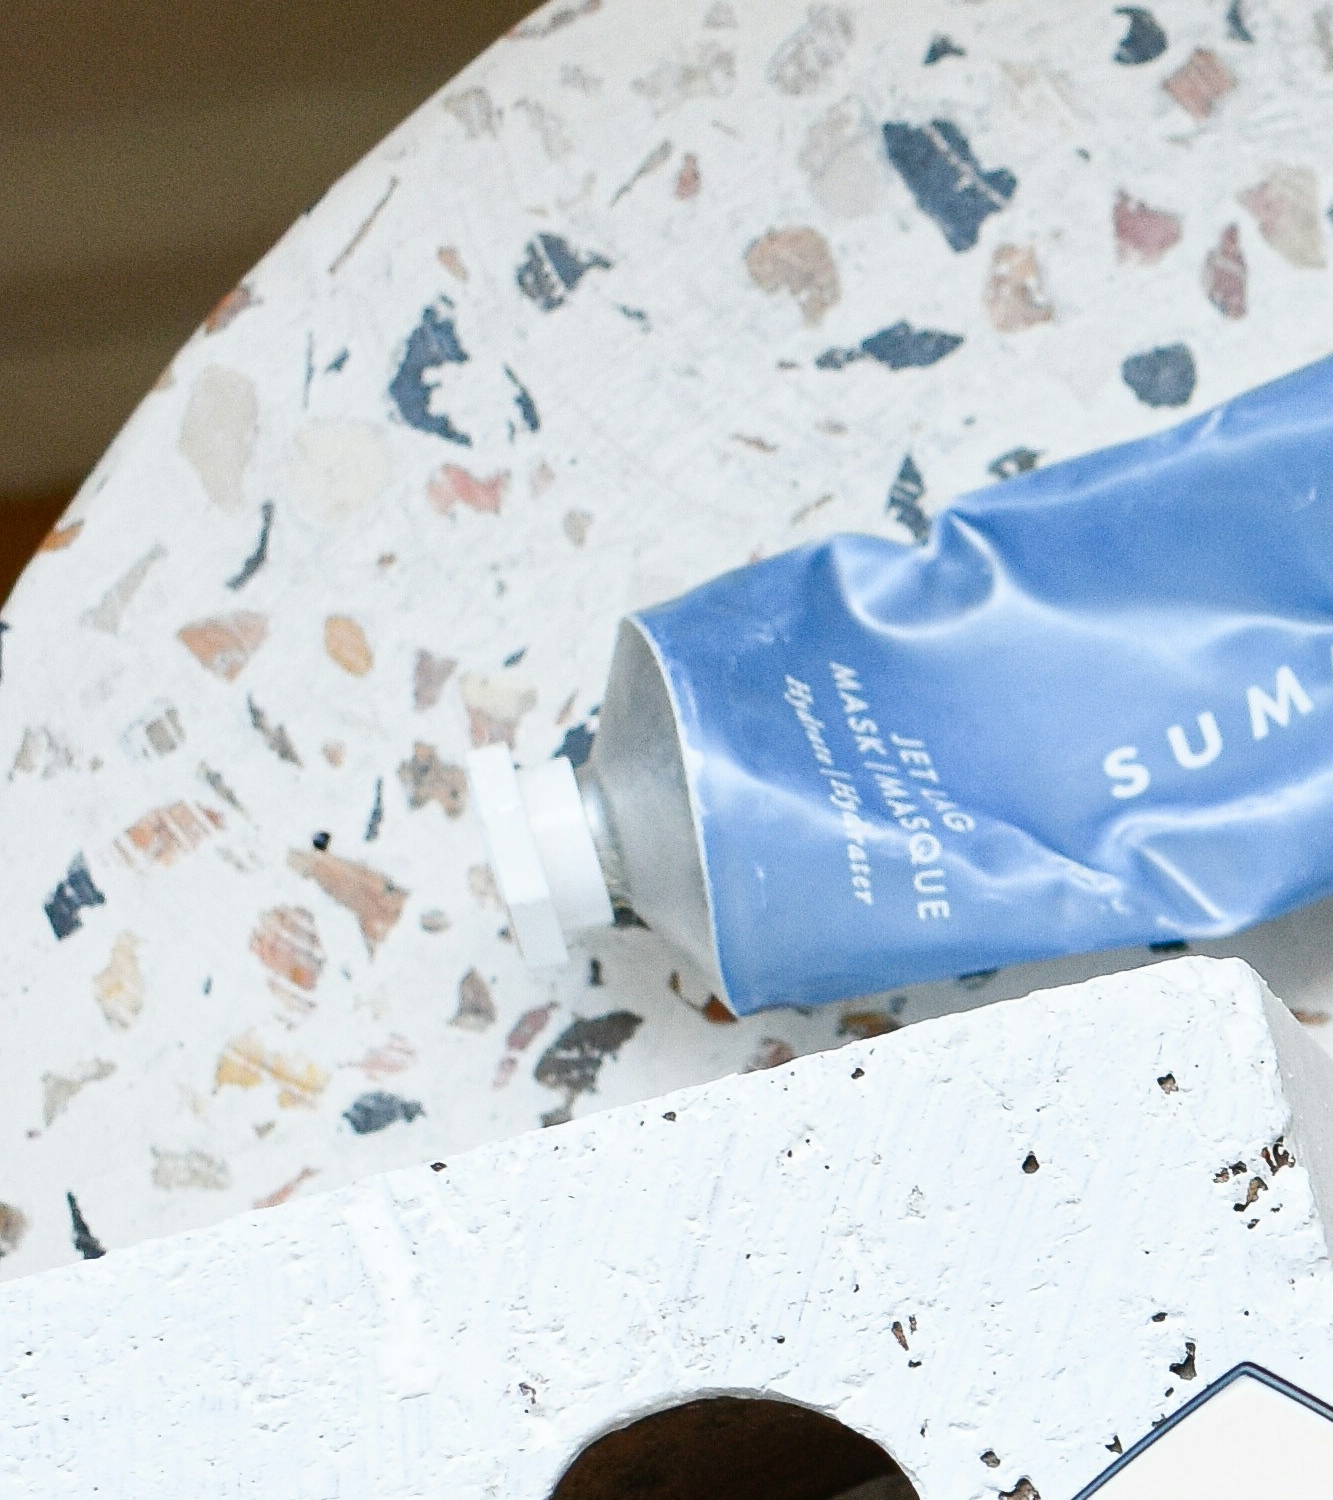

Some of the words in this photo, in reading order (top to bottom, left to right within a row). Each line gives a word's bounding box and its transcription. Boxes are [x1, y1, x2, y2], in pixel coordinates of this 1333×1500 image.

[829, 661, 888, 757] MASK
[874, 773, 951, 922] MASQUE
[890, 732, 940, 784] JET
